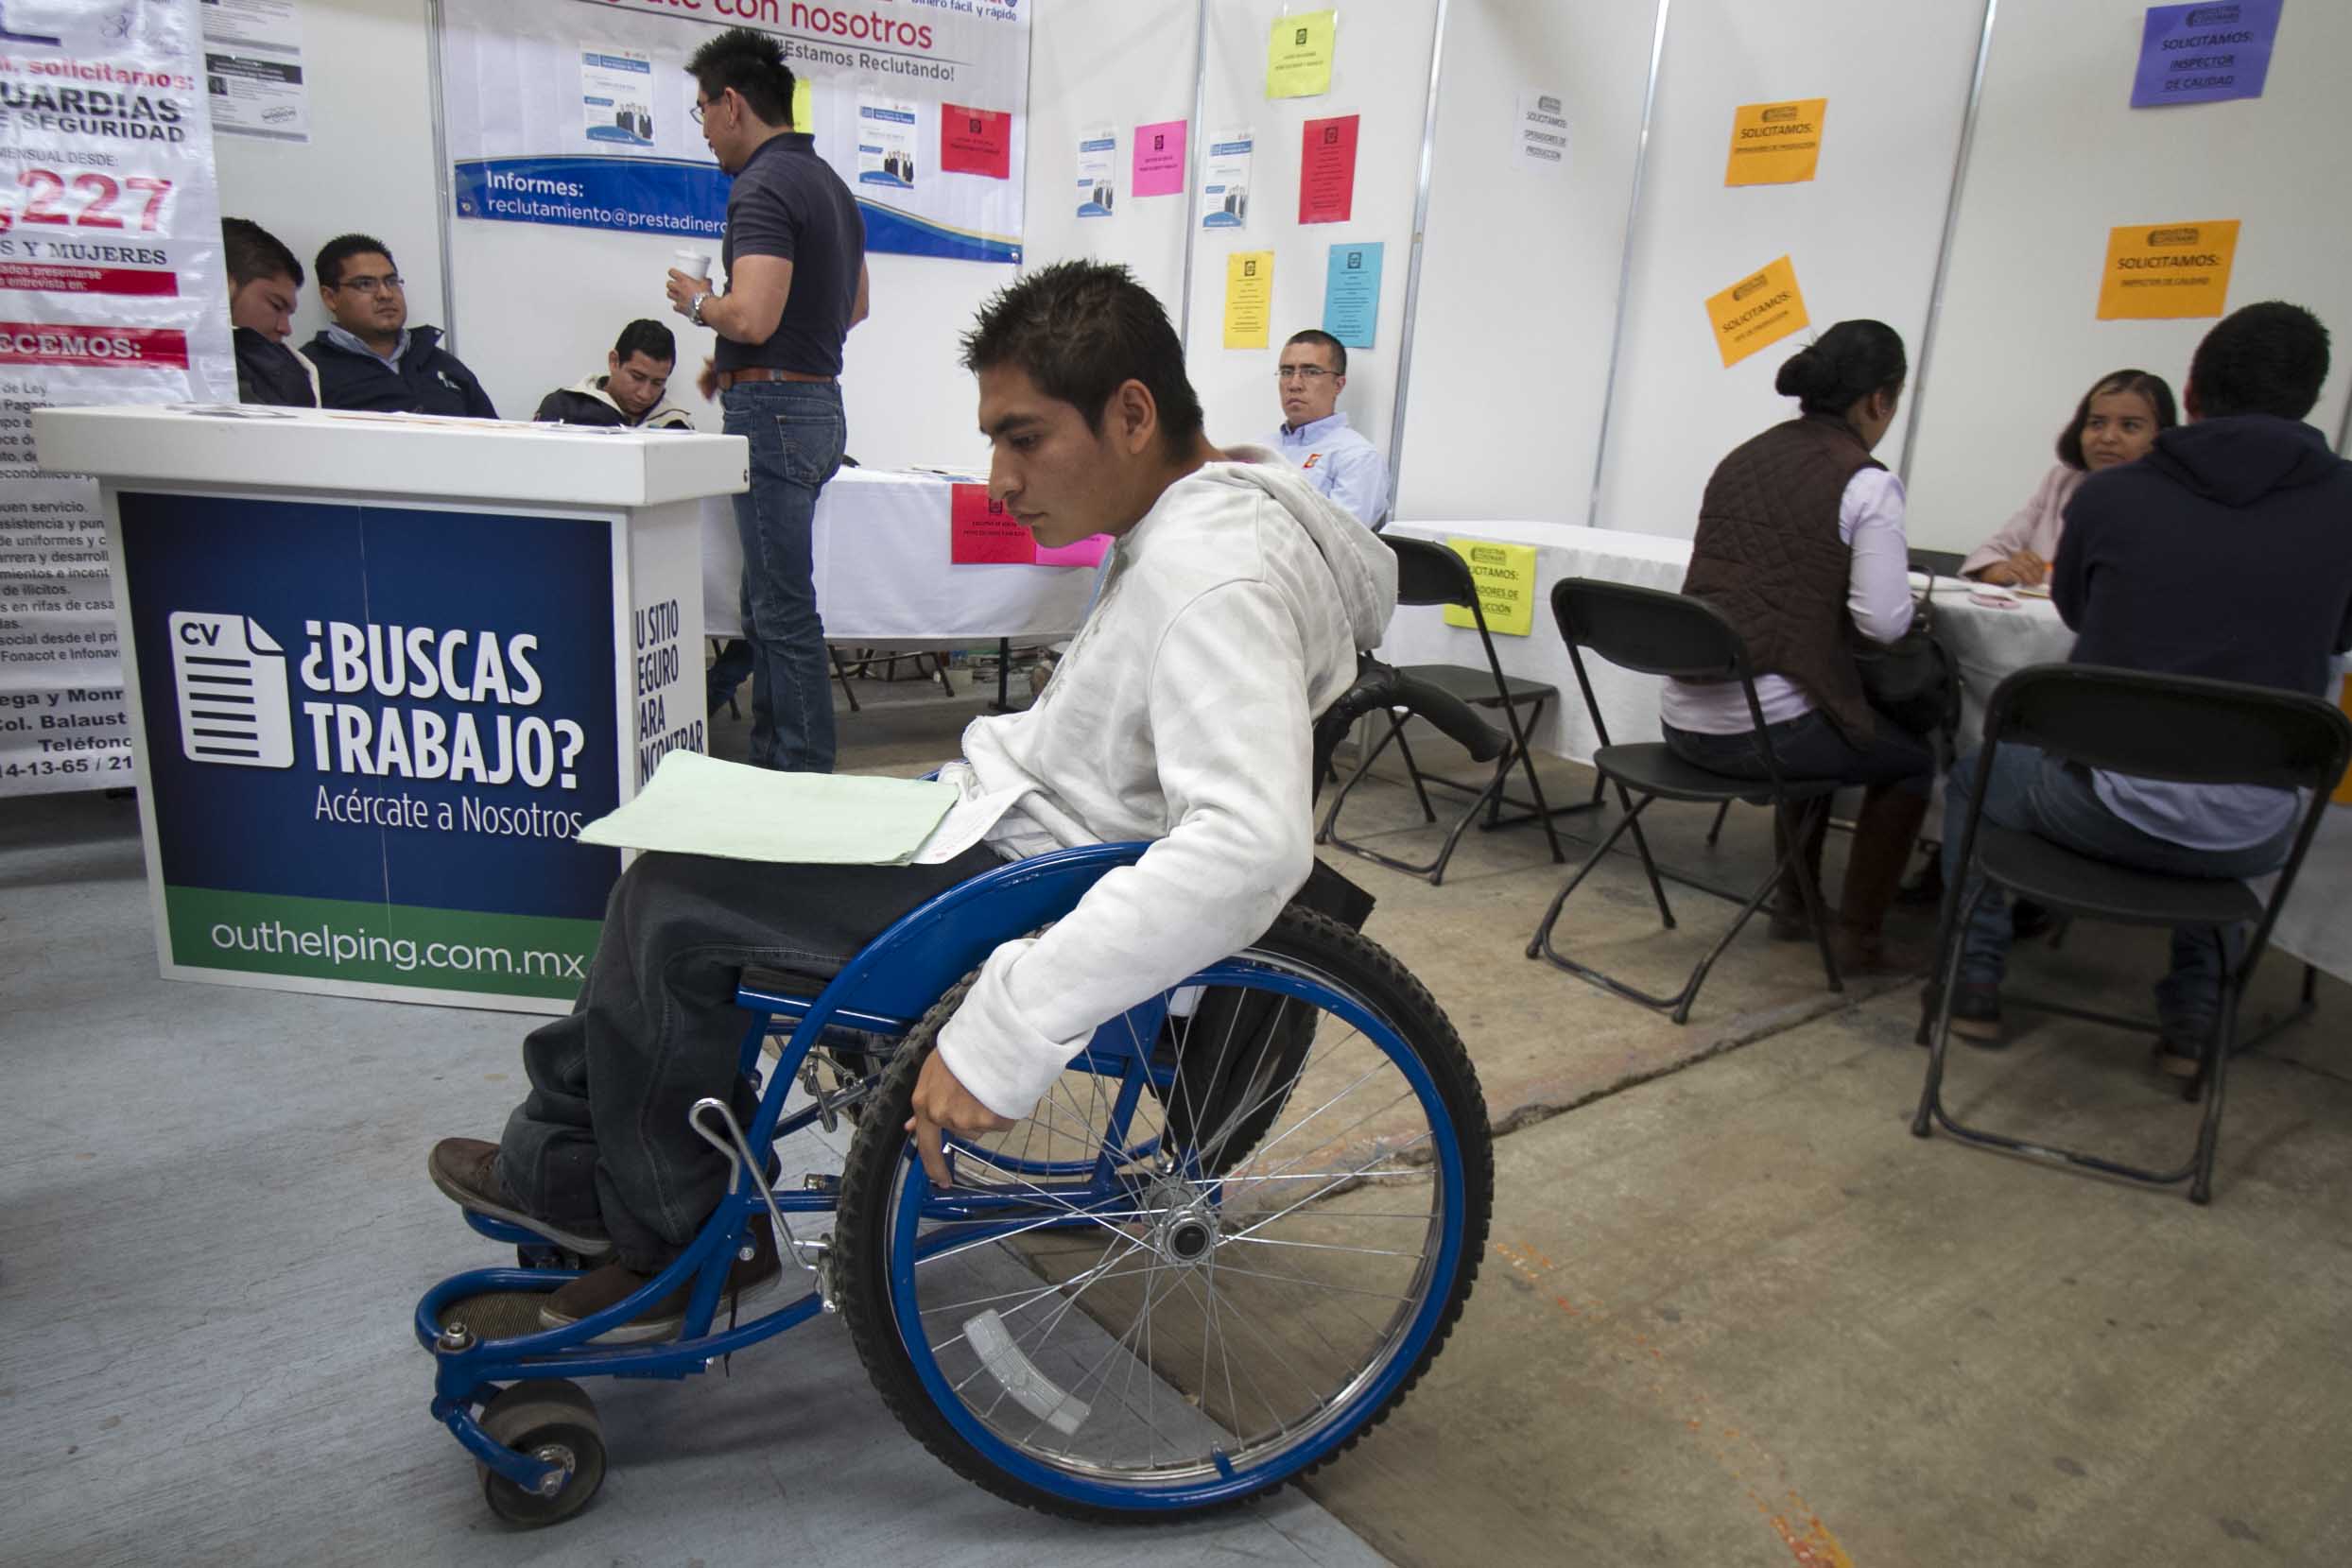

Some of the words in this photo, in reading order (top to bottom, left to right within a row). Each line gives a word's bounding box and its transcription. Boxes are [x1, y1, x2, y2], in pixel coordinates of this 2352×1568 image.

[715, 0, 779, 24] con
[791, 2, 933, 49] nosotros
[977, 7, 984, 17] y
[28, 59, 195, 90] solicitamos:
[859, 54, 955, 82] Reclutando!
[0, 81, 181, 124] UARDIAS
[21, 112, 185, 142] SEGURIDAD
[67, 150, 119, 167] DESDE:
[487, 170, 584, 198] Informes:
[488, 198, 727, 233] reclutamiento@prestadinero
[0, 240, 15, 256] S
[23, 240, 41, 257] Y
[48, 242, 168, 266] MUJERES
[0, 334, 142, 358] ECEMOS:
[67, 520, 76, 531] y
[79, 519, 105, 531] pun
[17, 534, 83, 547] uniformes
[86, 536, 95, 548] y
[51, 550, 110, 563] desarroll
[0, 568, 53, 579] mientos
[68, 568, 109, 578] incent
[3, 585, 19, 596] de
[12, 602, 28, 612] en
[65, 599, 81, 611] de
[85, 600, 114, 611] casa
[180, 622, 220, 646] CV
[649, 599, 679, 646] SITIO
[41, 631, 81, 644] desde
[84, 631, 95, 643] el
[99, 630, 117, 645] pri
[1, 648, 55, 663] Fonacot
[70, 646, 121, 660] Infonav
[301, 620, 543, 705] ¿BUSCAS
[637, 645, 679, 697] EGURO
[0, 694, 40, 709] ega
[46, 693, 60, 707] y
[67, 689, 124, 703] Monr
[0, 715, 32, 732] ol.
[40, 712, 128, 730] Balaust
[639, 694, 666, 743] ARA
[303, 701, 584, 789] TRABAJO?
[108, 755, 132, 770] 21
[315, 784, 429, 830] Acércate
[437, 803, 454, 831] a
[463, 797, 583, 839] Nosotros
[212, 922, 586, 978] outhelping.com.mx
